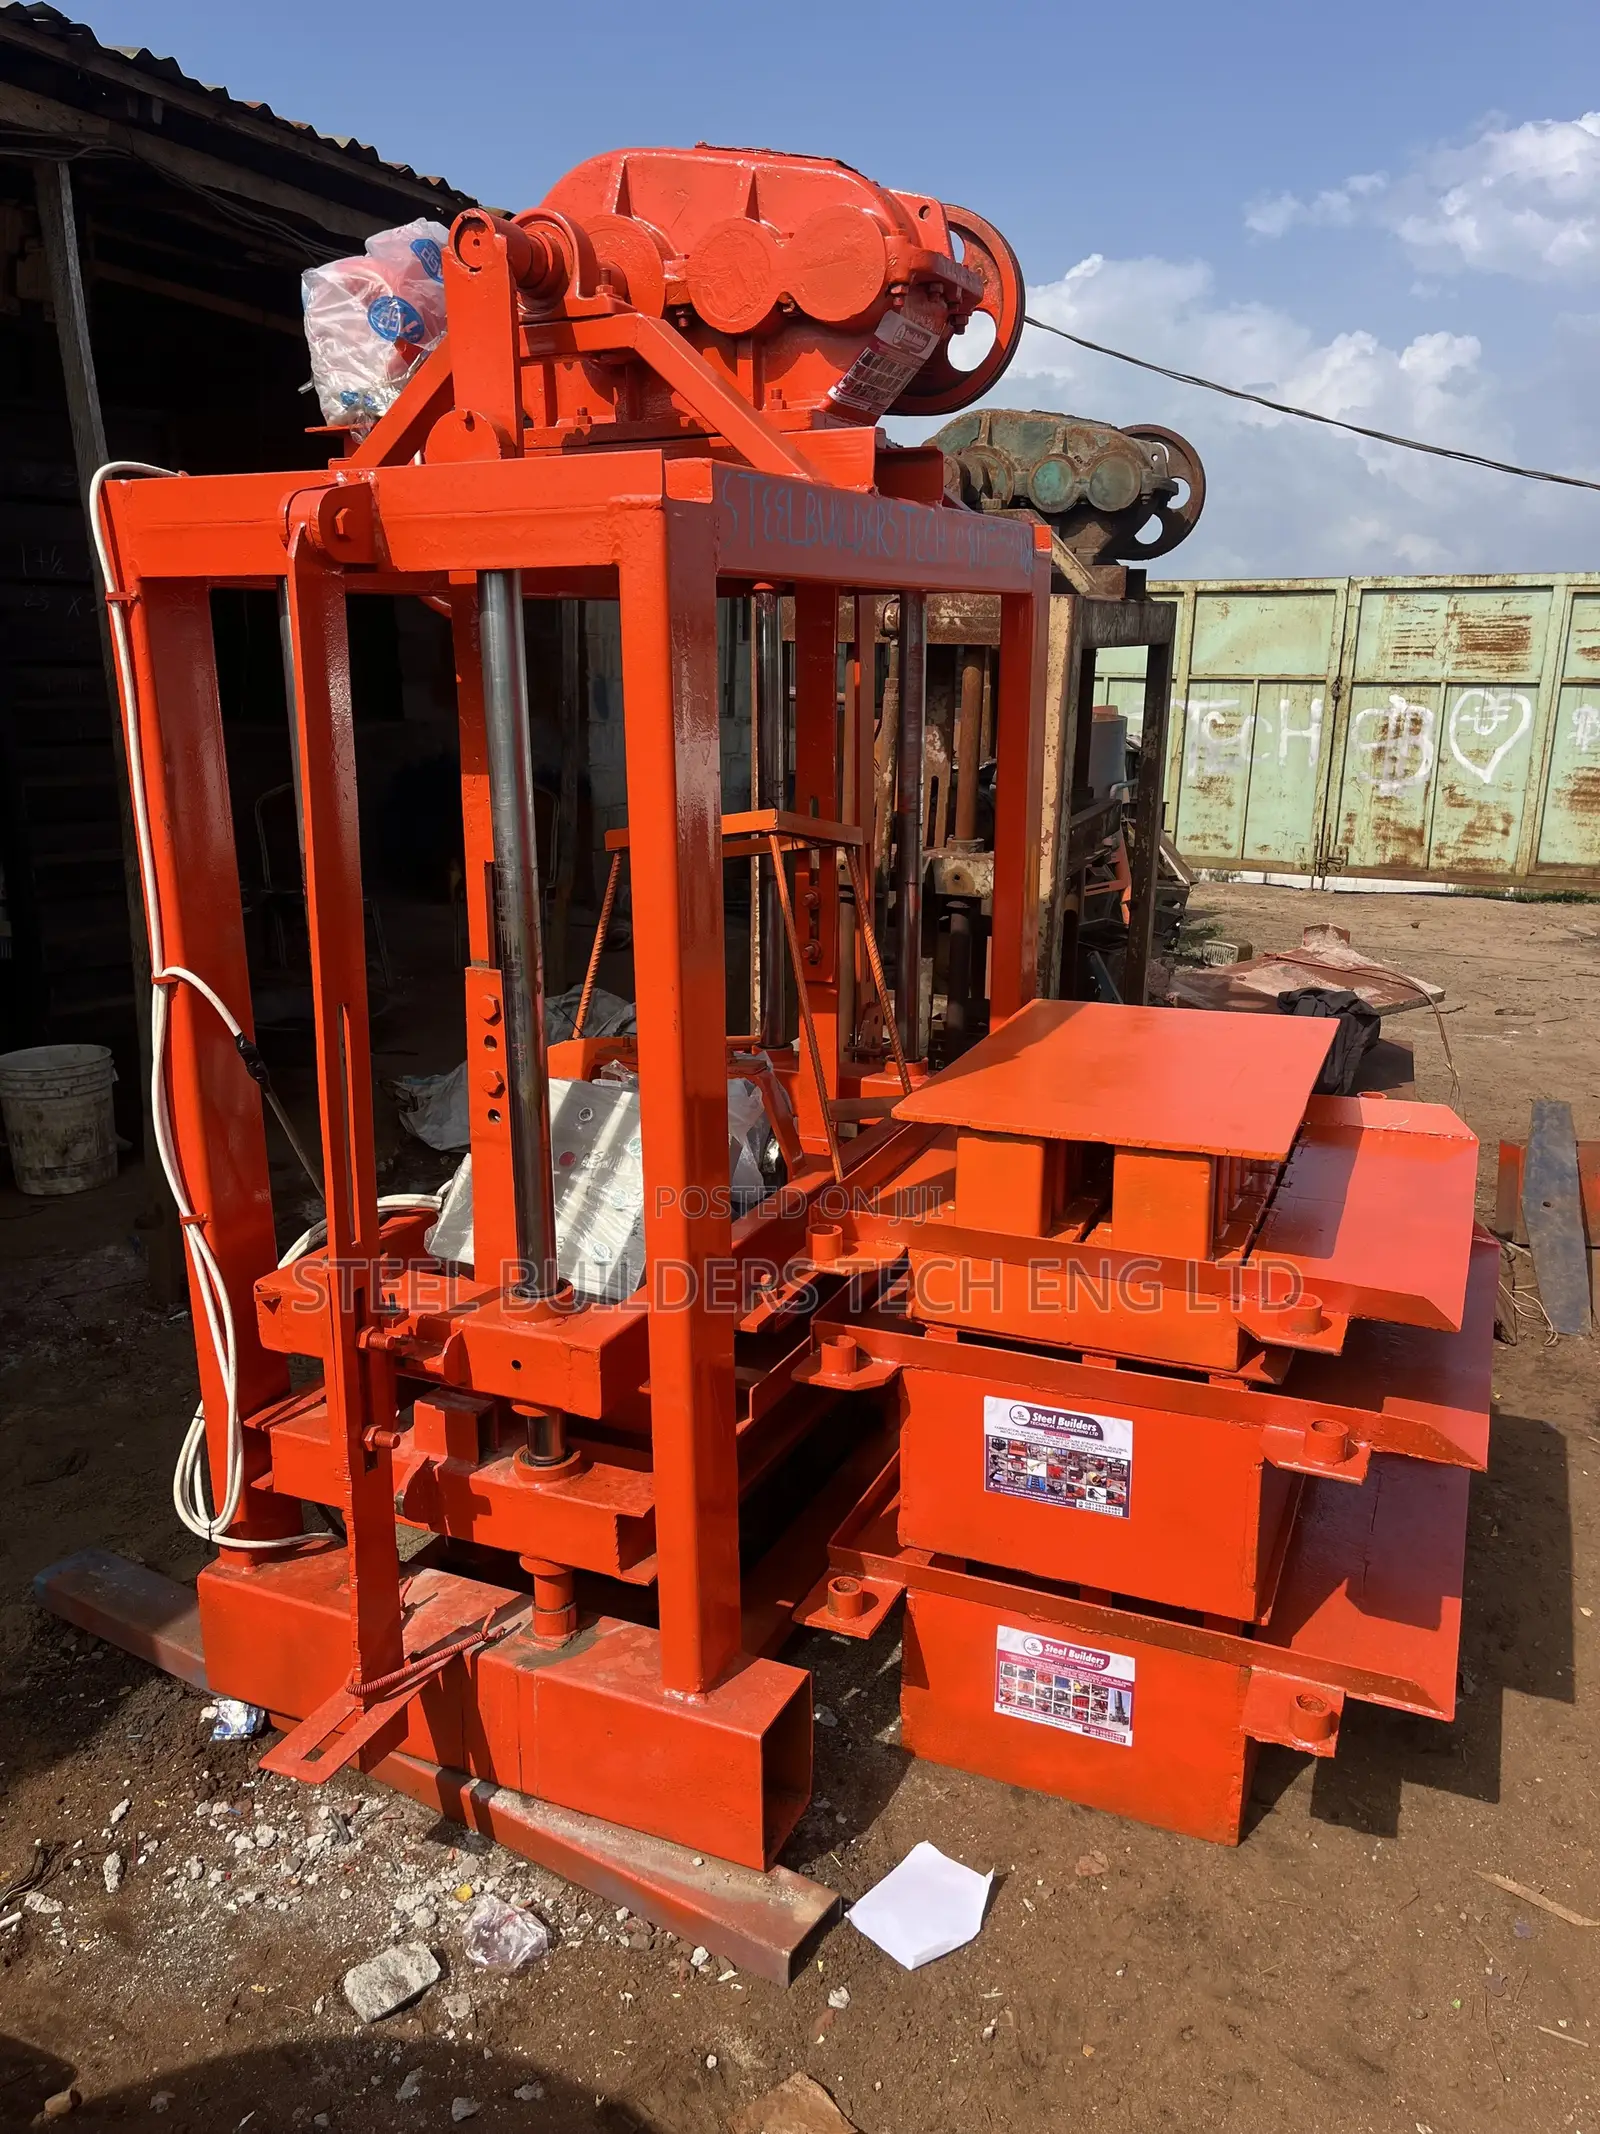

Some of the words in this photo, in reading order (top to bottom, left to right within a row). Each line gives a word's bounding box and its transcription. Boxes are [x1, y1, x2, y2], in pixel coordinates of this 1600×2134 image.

[1032, 1412, 1056, 1425] Steel
[1058, 1417, 1097, 1432] Builders
[1044, 1643, 1067, 1656] Steel
[1068, 1649, 1105, 1665] Builders
